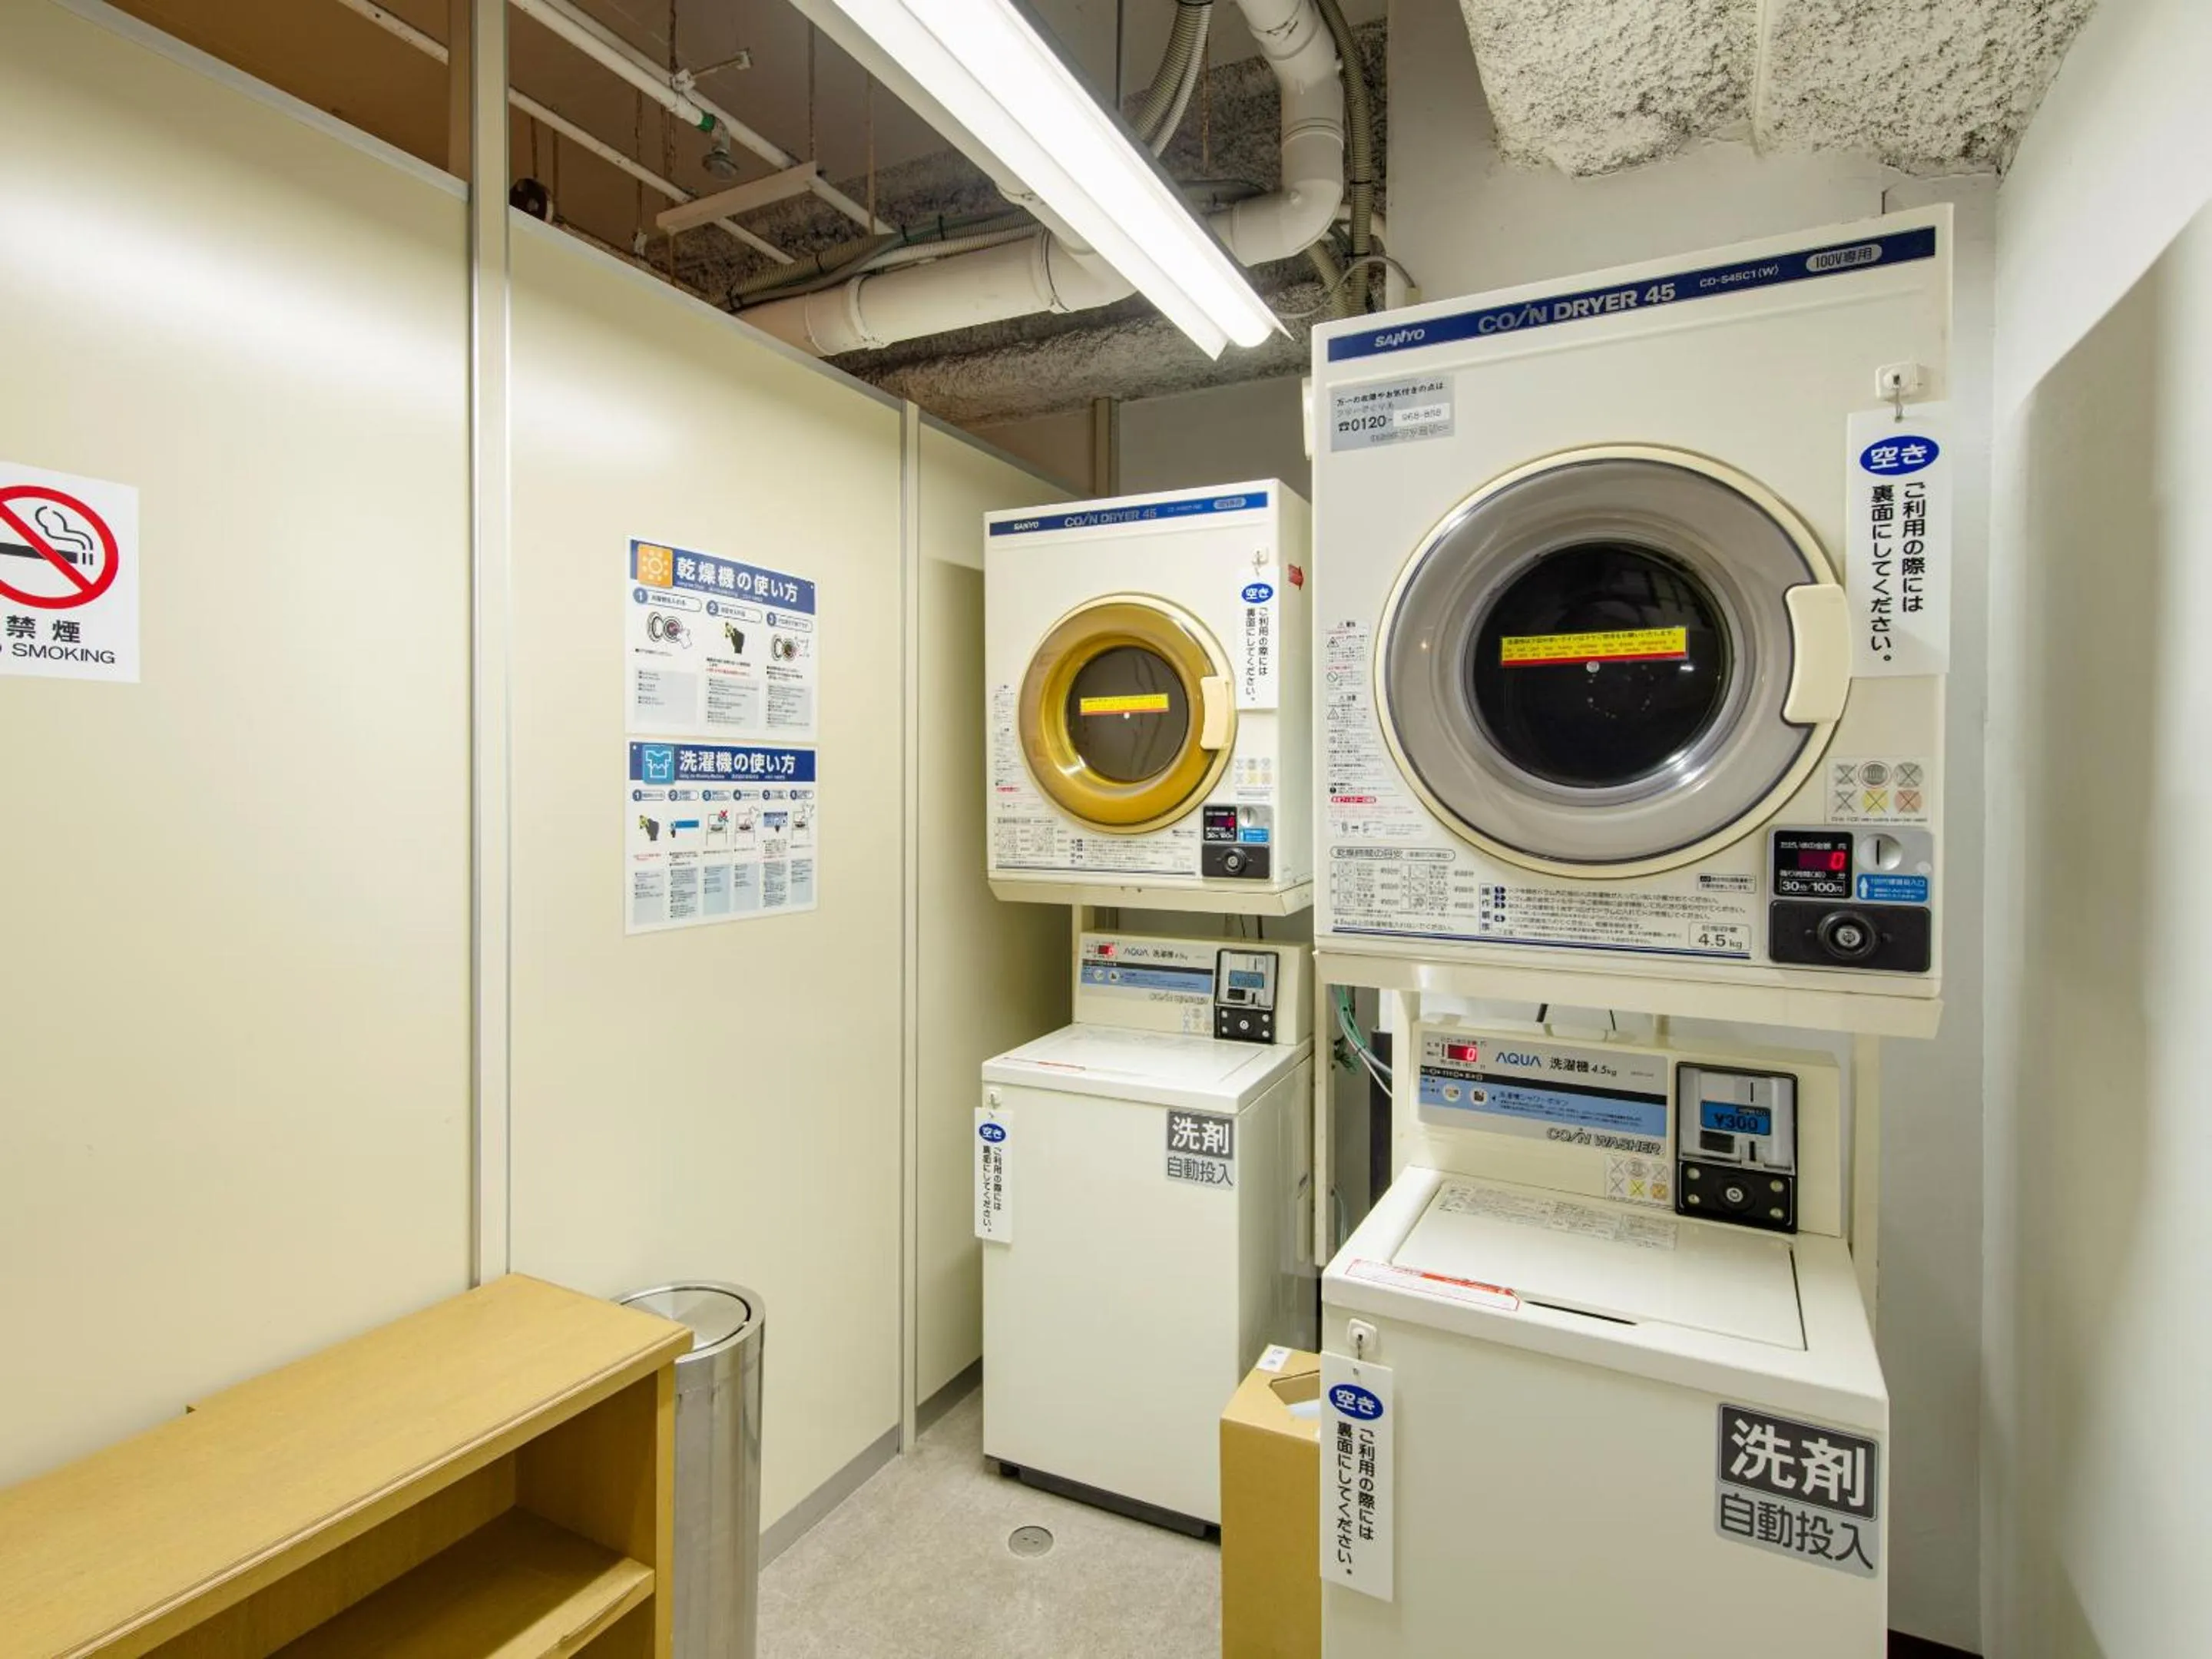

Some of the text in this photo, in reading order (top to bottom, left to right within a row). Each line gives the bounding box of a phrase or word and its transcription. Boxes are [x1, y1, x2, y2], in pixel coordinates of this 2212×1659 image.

[1374, 327, 1426, 348] SANYO
[1553, 290, 1637, 323] DRYER
[1644, 283, 1676, 304] 45
[1870, 443, 1928, 470] 空き
[1902, 481, 1926, 613] ご利用の際には
[677, 557, 799, 603] 乾燥機の使い方
[1870, 484, 1895, 662] 裏面にしてください。
[1245, 587, 1270, 600] 空き
[6, 615, 81, 644] 禁煙
[1258, 607, 1269, 676] ご利用の際には
[12, 643, 116, 664] SMOKING
[680, 749, 796, 774] 洗濯機の使い方
[1830, 852, 1846, 870] 0
[1698, 933, 1727, 947] 4.5
[1466, 1048, 1476, 1061] 0
[1495, 1051, 1542, 1068] AQUA
[1549, 1057, 1589, 1073] 洗濯機
[1171, 1115, 1230, 1154] 洗剤
[1167, 1155, 1233, 1187] 自動投入
[1336, 1389, 1376, 1416] 空き
[1730, 1418, 1866, 1507] 洗剤
[1336, 1420, 1354, 1575] 裏面にしてください。
[1357, 1427, 1376, 1541] ご利用の際には
[1720, 1493, 1874, 1570] 自動投入
